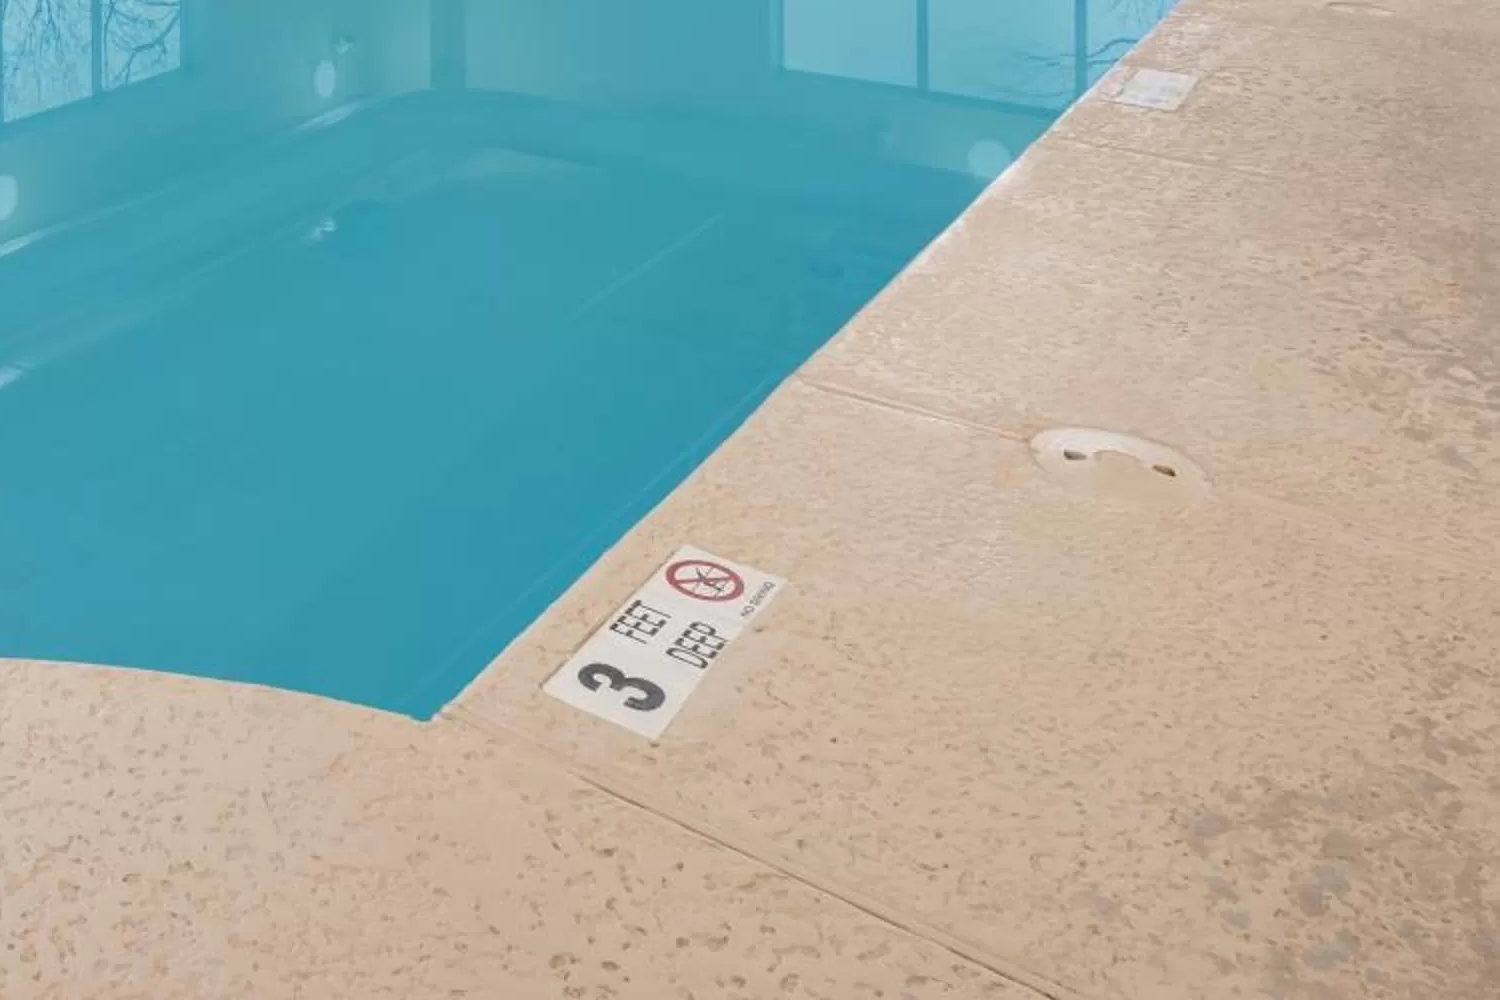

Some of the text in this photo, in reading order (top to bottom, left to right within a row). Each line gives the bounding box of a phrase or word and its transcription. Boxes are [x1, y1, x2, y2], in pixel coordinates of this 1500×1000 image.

[609, 599, 672, 645] FEET
[665, 620, 729, 670] DEEP
[577, 662, 666, 712] 3
